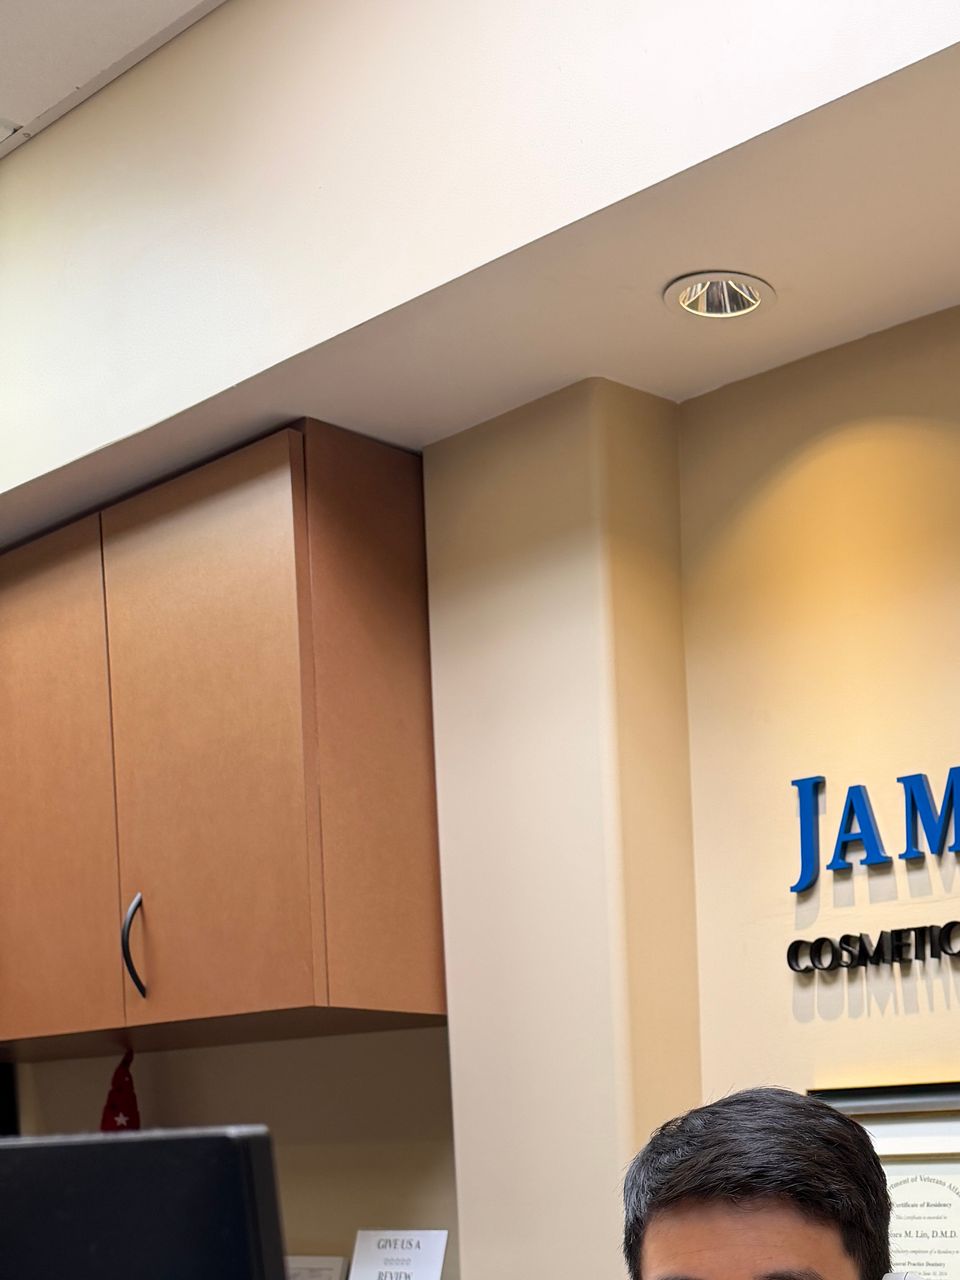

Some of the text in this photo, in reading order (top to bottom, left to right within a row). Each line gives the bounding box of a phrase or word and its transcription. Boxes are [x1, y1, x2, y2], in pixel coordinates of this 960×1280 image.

[919, 1174, 947, 1187] Veterans
[377, 1238, 421, 1250] GIVE US A
